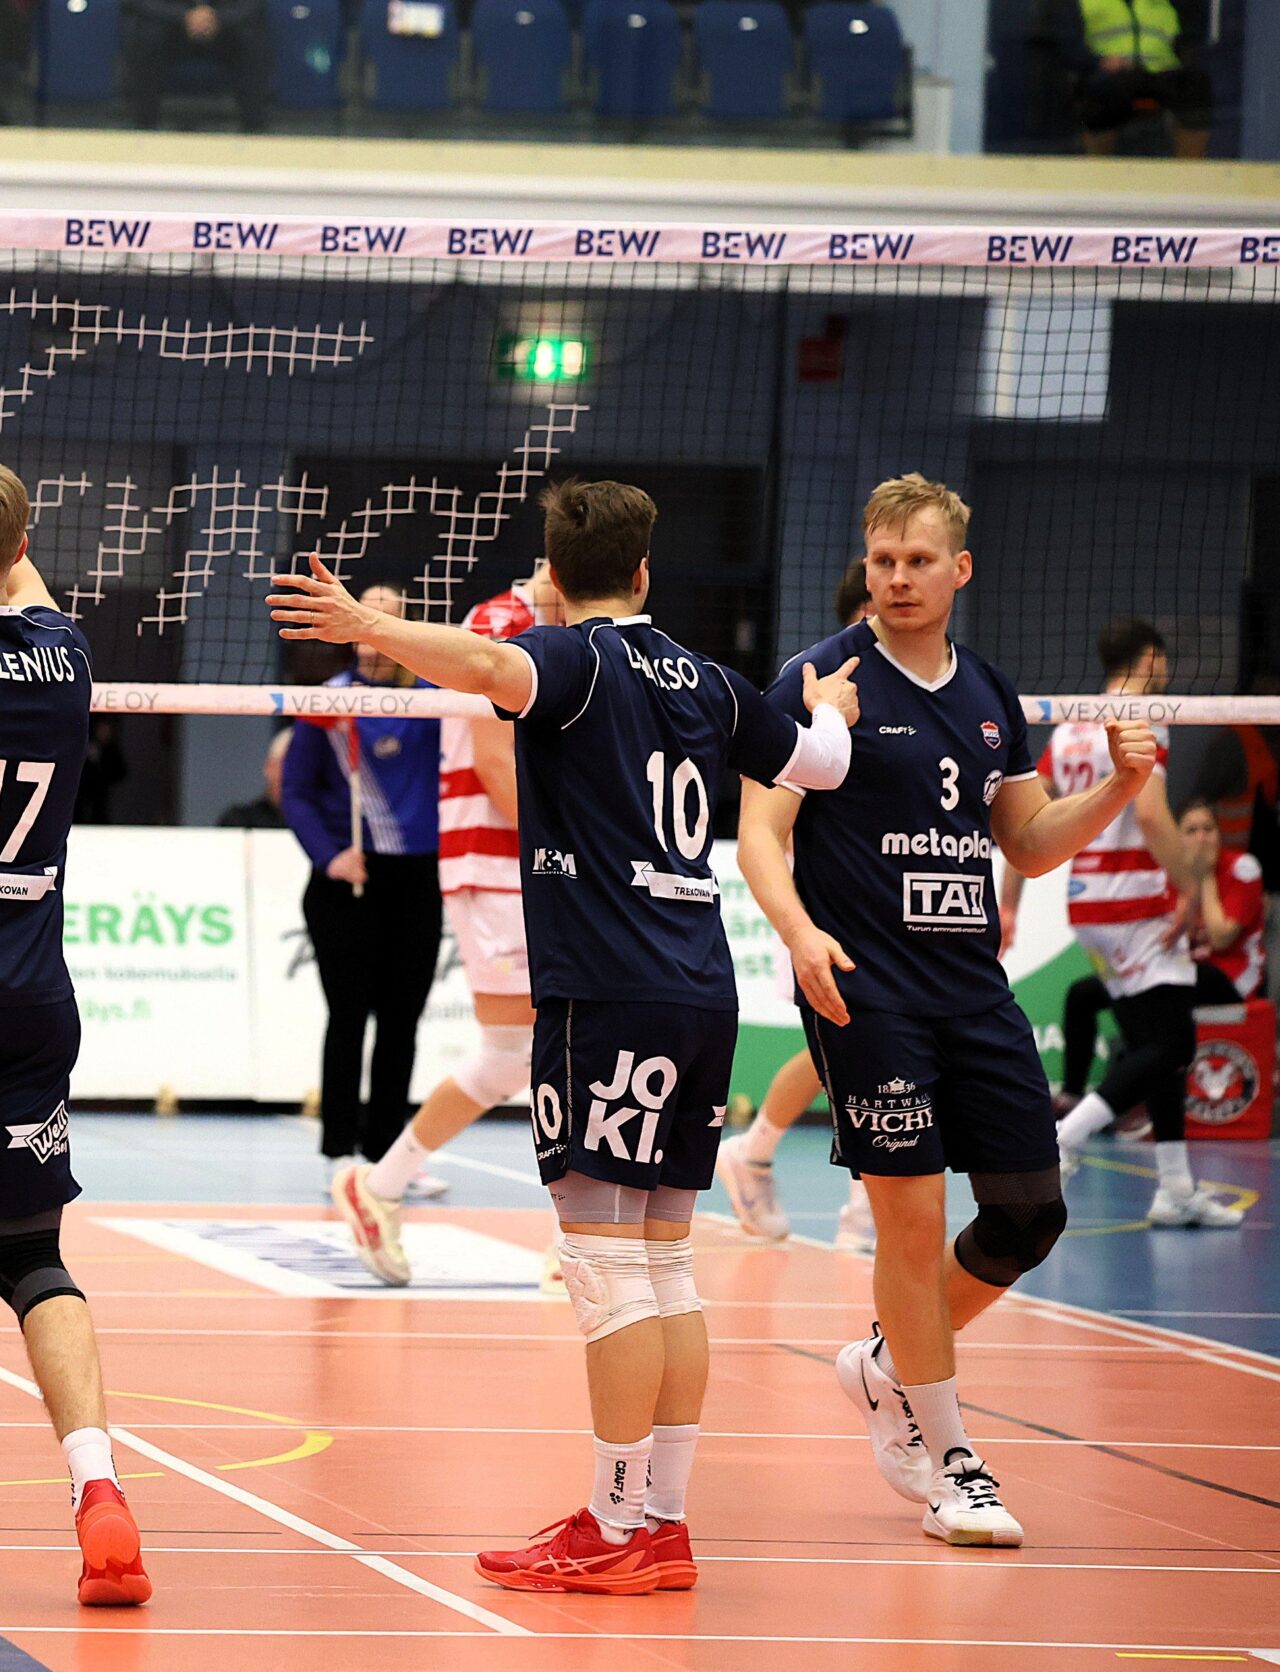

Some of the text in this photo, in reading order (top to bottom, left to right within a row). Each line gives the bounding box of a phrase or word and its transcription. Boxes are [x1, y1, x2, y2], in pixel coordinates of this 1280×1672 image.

[66, 220, 150, 247] BEWI
[194, 222, 278, 249] BEWI
[321, 227, 405, 252] BEWI
[448, 229, 533, 254] BEWI
[575, 230, 660, 256] BEWI
[702, 232, 786, 259] BEWI
[829, 234, 913, 260] BEWI
[987, 236, 1073, 262] BEWI
[1112, 237, 1198, 263] BEWI
[1240, 237, 1280, 263] BE
[124, 691, 160, 710] OY
[291, 694, 414, 715] VEXVE OY
[1059, 702, 1182, 721] VEXVE OY
[879, 726, 907, 735] CRAFT
[938, 756, 960, 812] 3
[646, 750, 709, 861] 10
[881, 828, 992, 864] metapla
[912, 881, 982, 916] TAI
[588, 1049, 678, 1110] JO
[583, 1099, 664, 1165] KI.
[845, 1106, 934, 1133] VICHY
[872, 1134, 920, 1153] Original
[613, 1460, 627, 1493] CRAFT
